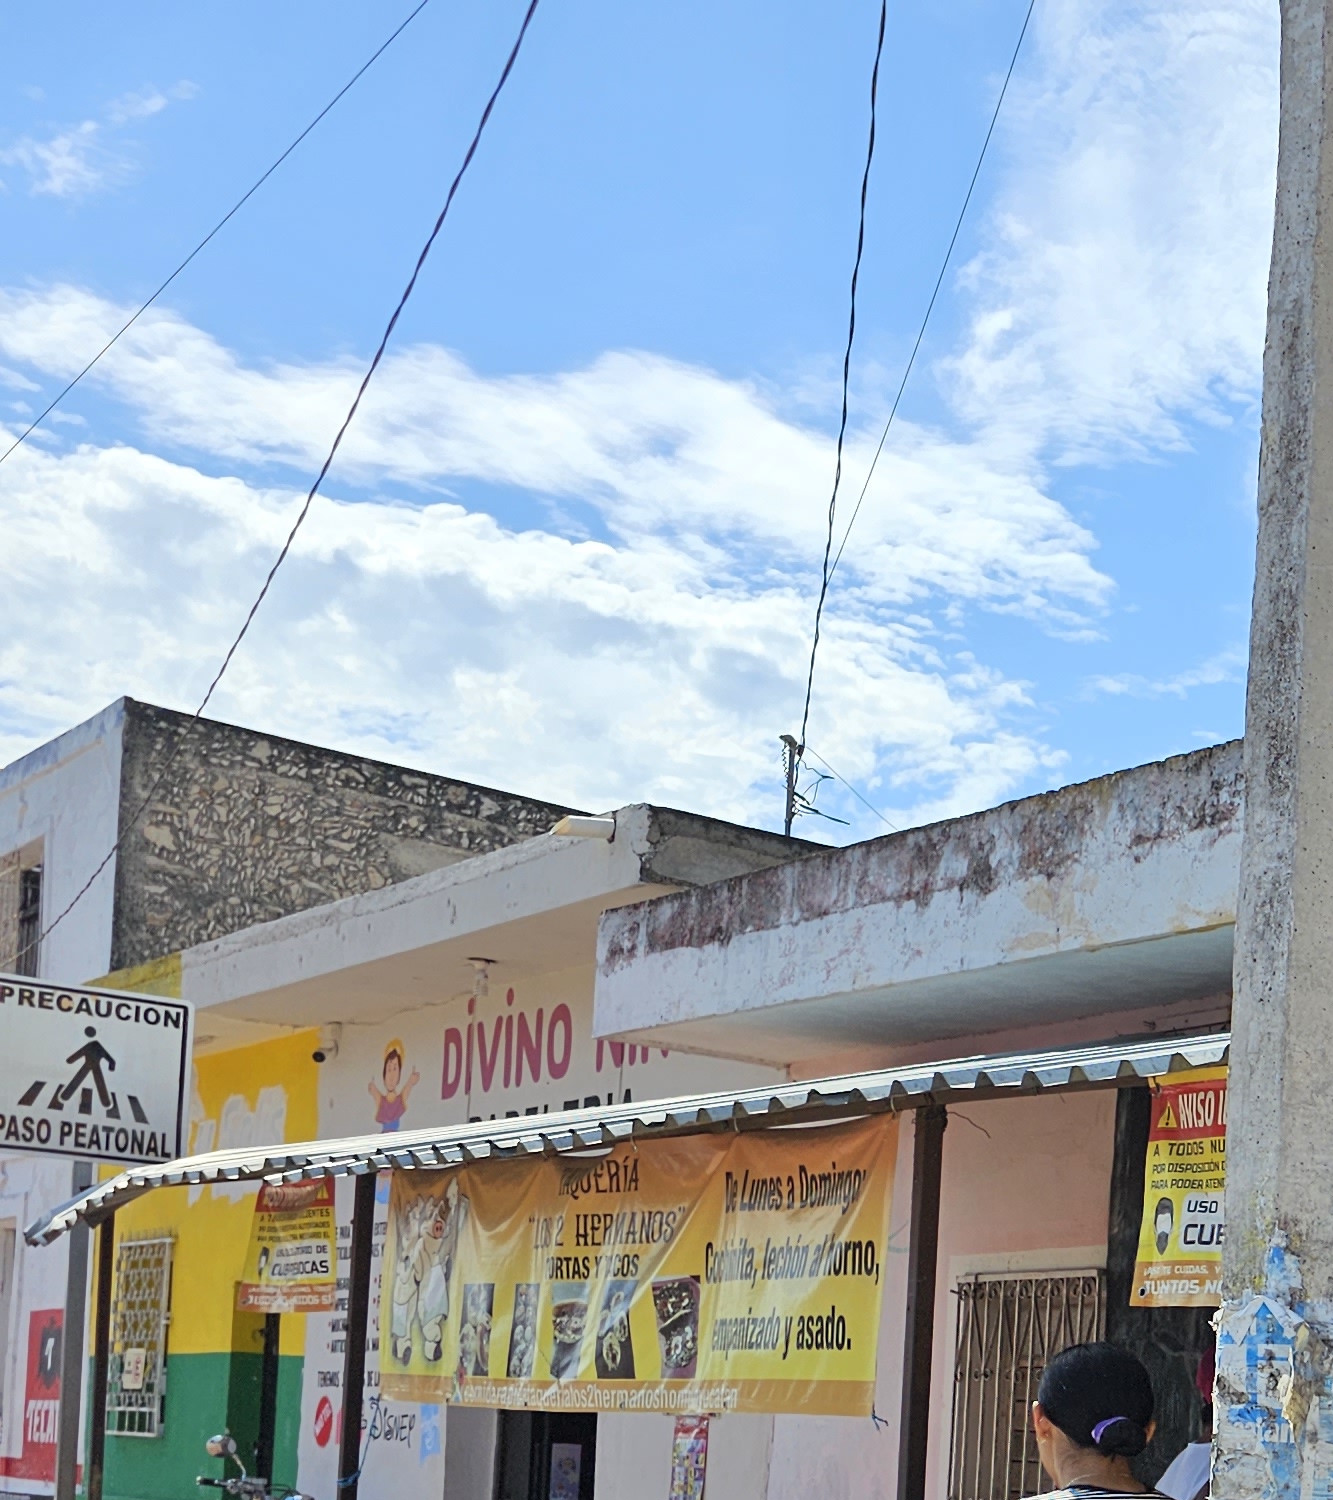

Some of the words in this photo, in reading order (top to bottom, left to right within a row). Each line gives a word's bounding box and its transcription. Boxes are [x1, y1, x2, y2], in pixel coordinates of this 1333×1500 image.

[0, 985, 181, 1029] PRECAUCION
[1178, 1090, 1215, 1129] AVISO
[0, 1114, 51, 1145] PASO
[59, 1121, 172, 1158] PEATONAL
[1153, 1144, 1160, 1157] A
[1168, 1141, 1204, 1156] TODOS
[1210, 1140, 1226, 1154] NU
[559, 1156, 639, 1200] QUERÍA
[1152, 1163, 1166, 1174] POR
[1167, 1159, 1219, 1173] DISPOSICIÓN
[725, 1171, 738, 1214] De
[740, 1169, 783, 1212] Lunes
[786, 1175, 795, 1210] a
[1151, 1179, 1168, 1190] PARA
[1170, 1178, 1203, 1190] PODER
[1205, 1177, 1226, 1189] ATEN
[1187, 1200, 1218, 1213] USO
[555, 1215, 564, 1247] 2
[1183, 1223, 1225, 1246] CUB
[316, 1245, 328, 1254] DE
[761, 1234, 809, 1280] lechón
[809, 1234, 828, 1278] al
[546, 1256, 590, 1280] ORTAS
[1144, 1279, 1199, 1295] JUNTOS
[712, 1306, 781, 1360] empanizado
[782, 1315, 793, 1360] y
[796, 1305, 852, 1351] asado.
